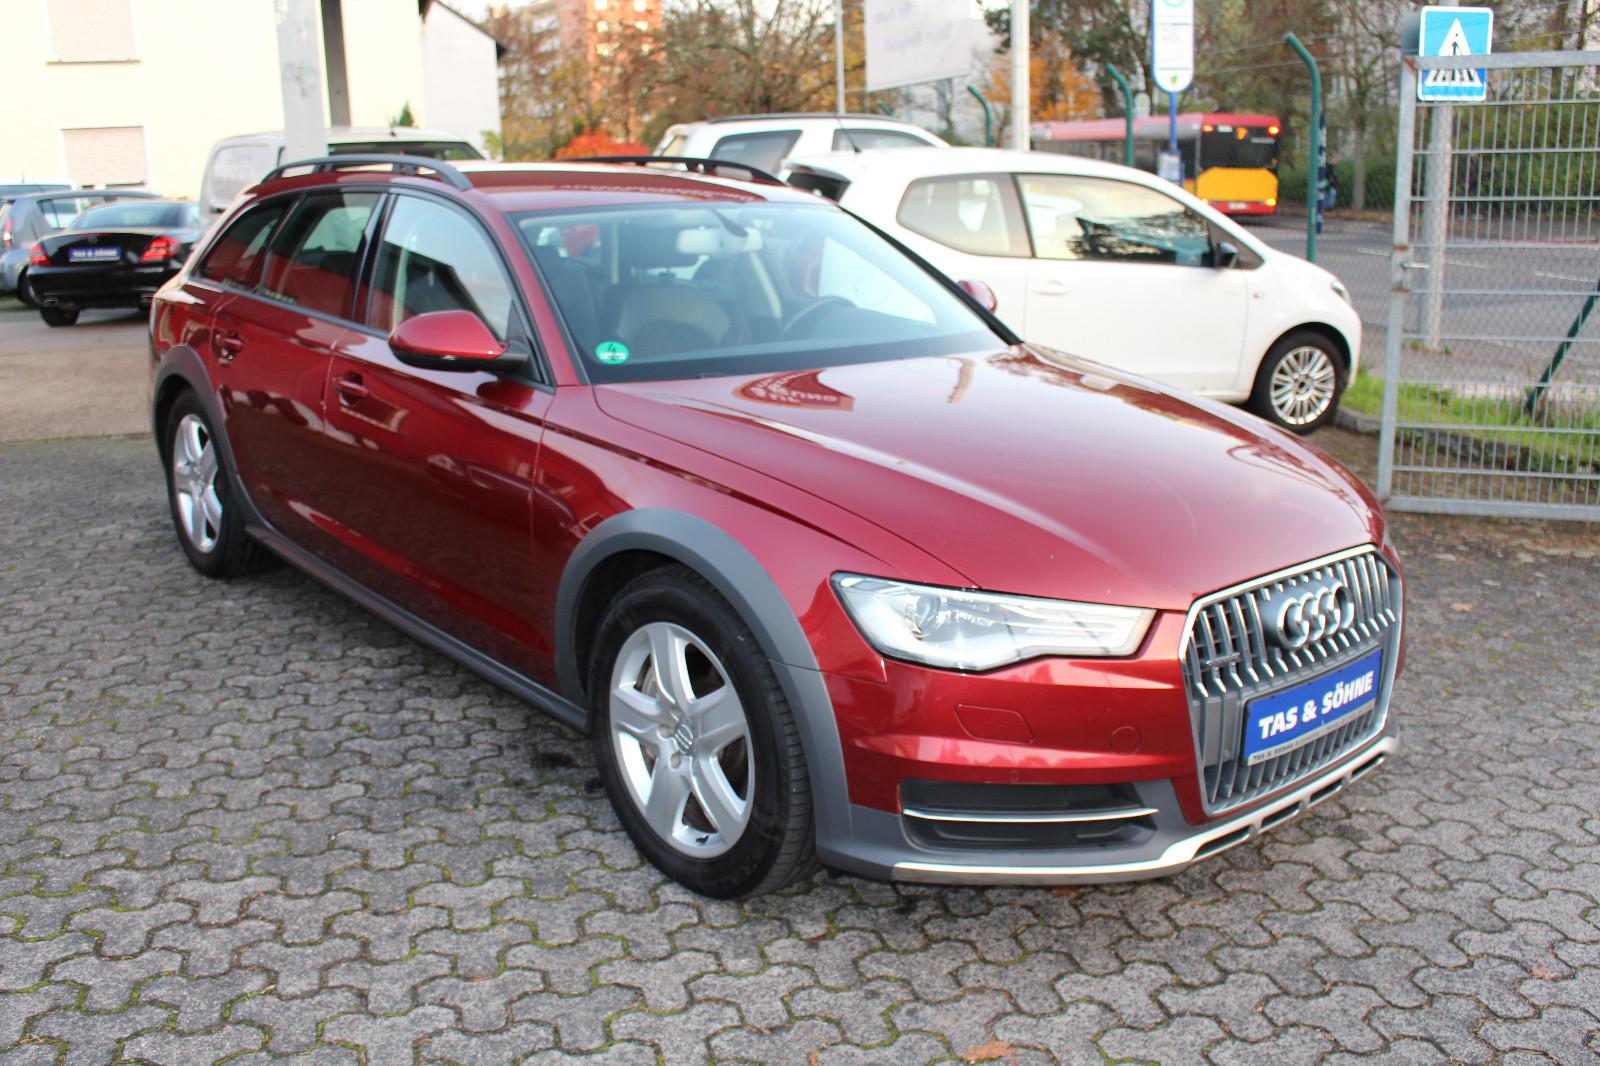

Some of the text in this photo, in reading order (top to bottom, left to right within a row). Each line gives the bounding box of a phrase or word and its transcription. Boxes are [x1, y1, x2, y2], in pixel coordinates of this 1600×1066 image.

[1258, 706, 1298, 739] TAS
[1301, 699, 1318, 723] &
[1321, 670, 1374, 715] SÖHNE
